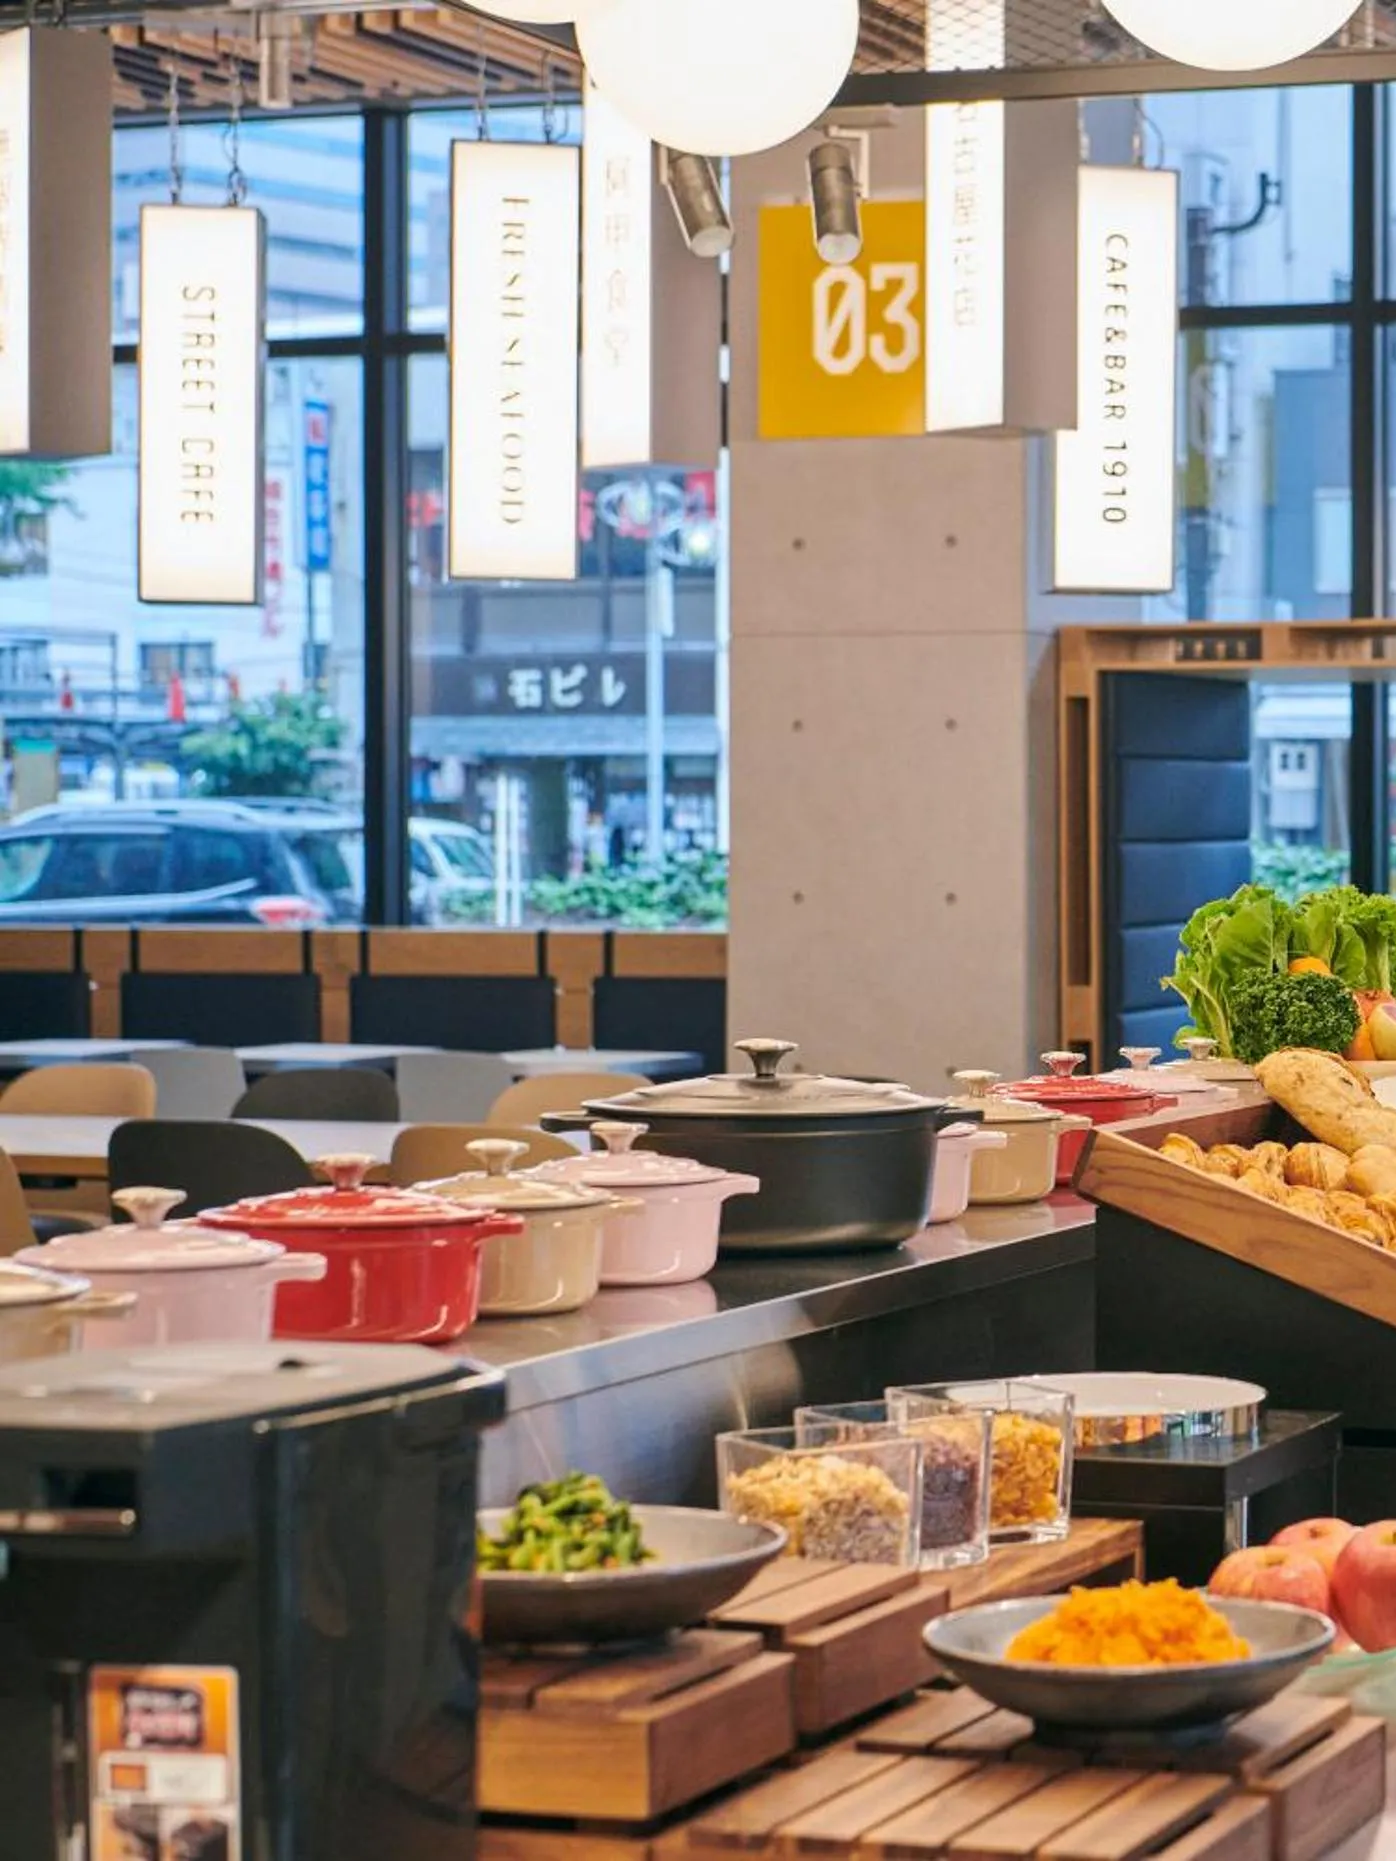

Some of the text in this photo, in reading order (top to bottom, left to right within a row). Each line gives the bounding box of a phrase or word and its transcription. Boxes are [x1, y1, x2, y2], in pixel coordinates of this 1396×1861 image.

[179, 284, 216, 524] STREET CAFE
[1101, 232, 1128, 524] CAFE&BAR 1910
